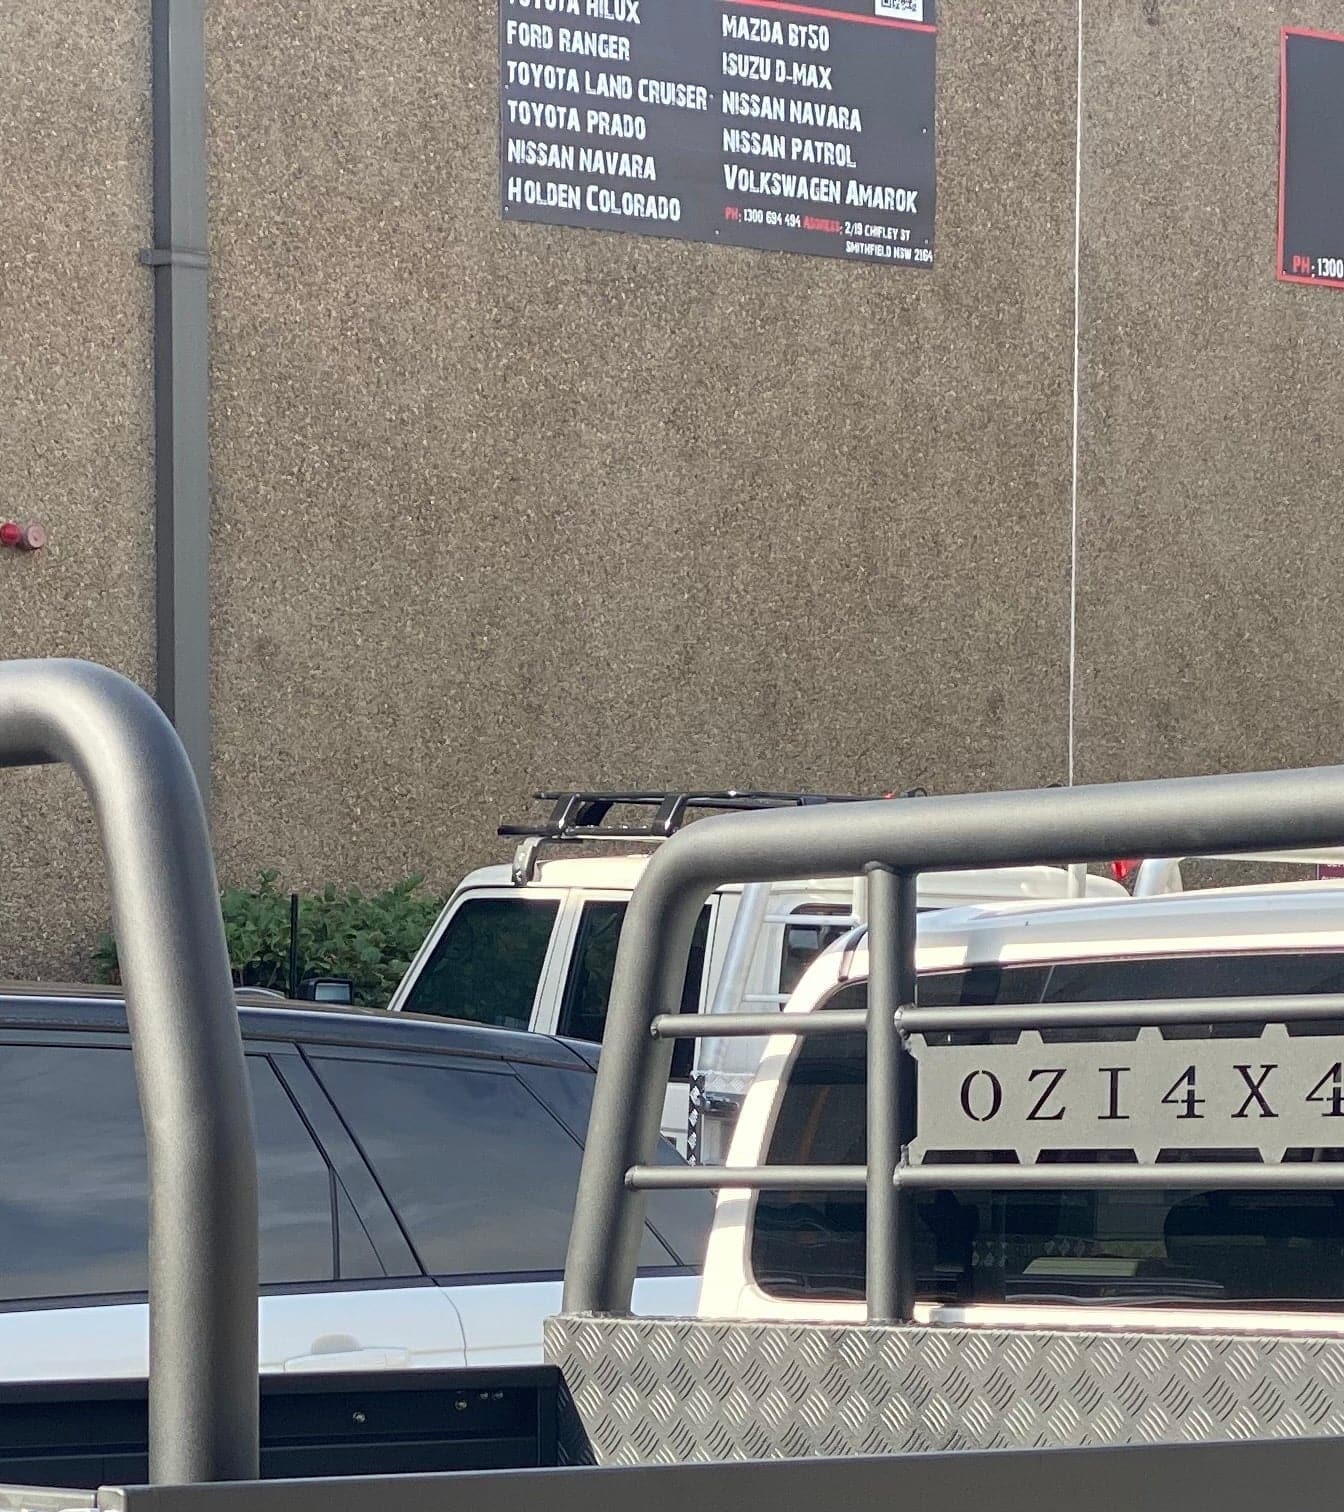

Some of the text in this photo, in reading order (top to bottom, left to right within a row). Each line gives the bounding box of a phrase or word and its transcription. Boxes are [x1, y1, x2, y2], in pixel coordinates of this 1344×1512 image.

[586, 0, 641, 24] HILUX
[722, 14, 783, 46] MAZDA
[507, 19, 630, 61] FORD RANGER
[507, 60, 708, 110] TOYOTA LAND CRUISER
[722, 52, 832, 90] ISUZU D-MAX
[508, 99, 646, 140] TOYOTA PRADO
[722, 90, 862, 132] NISSAN NAVARA
[507, 138, 656, 181] NISSAN NAVARA
[723, 128, 857, 168] NISSAN PATROL
[508, 177, 681, 221] HOLDEN COLORADO
[723, 164, 918, 213] VOLKSWAGEN AMAROK
[744, 208, 763, 224] 1300
[766, 210, 782, 226] 694
[784, 213, 801, 228] 494
[844, 220, 863, 237] 2/19
[865, 223, 899, 241] CHIFLEY
[900, 228, 911, 241] ST
[846, 240, 933, 262] SMITHFIELD NSW 2164
[1317, 257, 1344, 278] 1300
